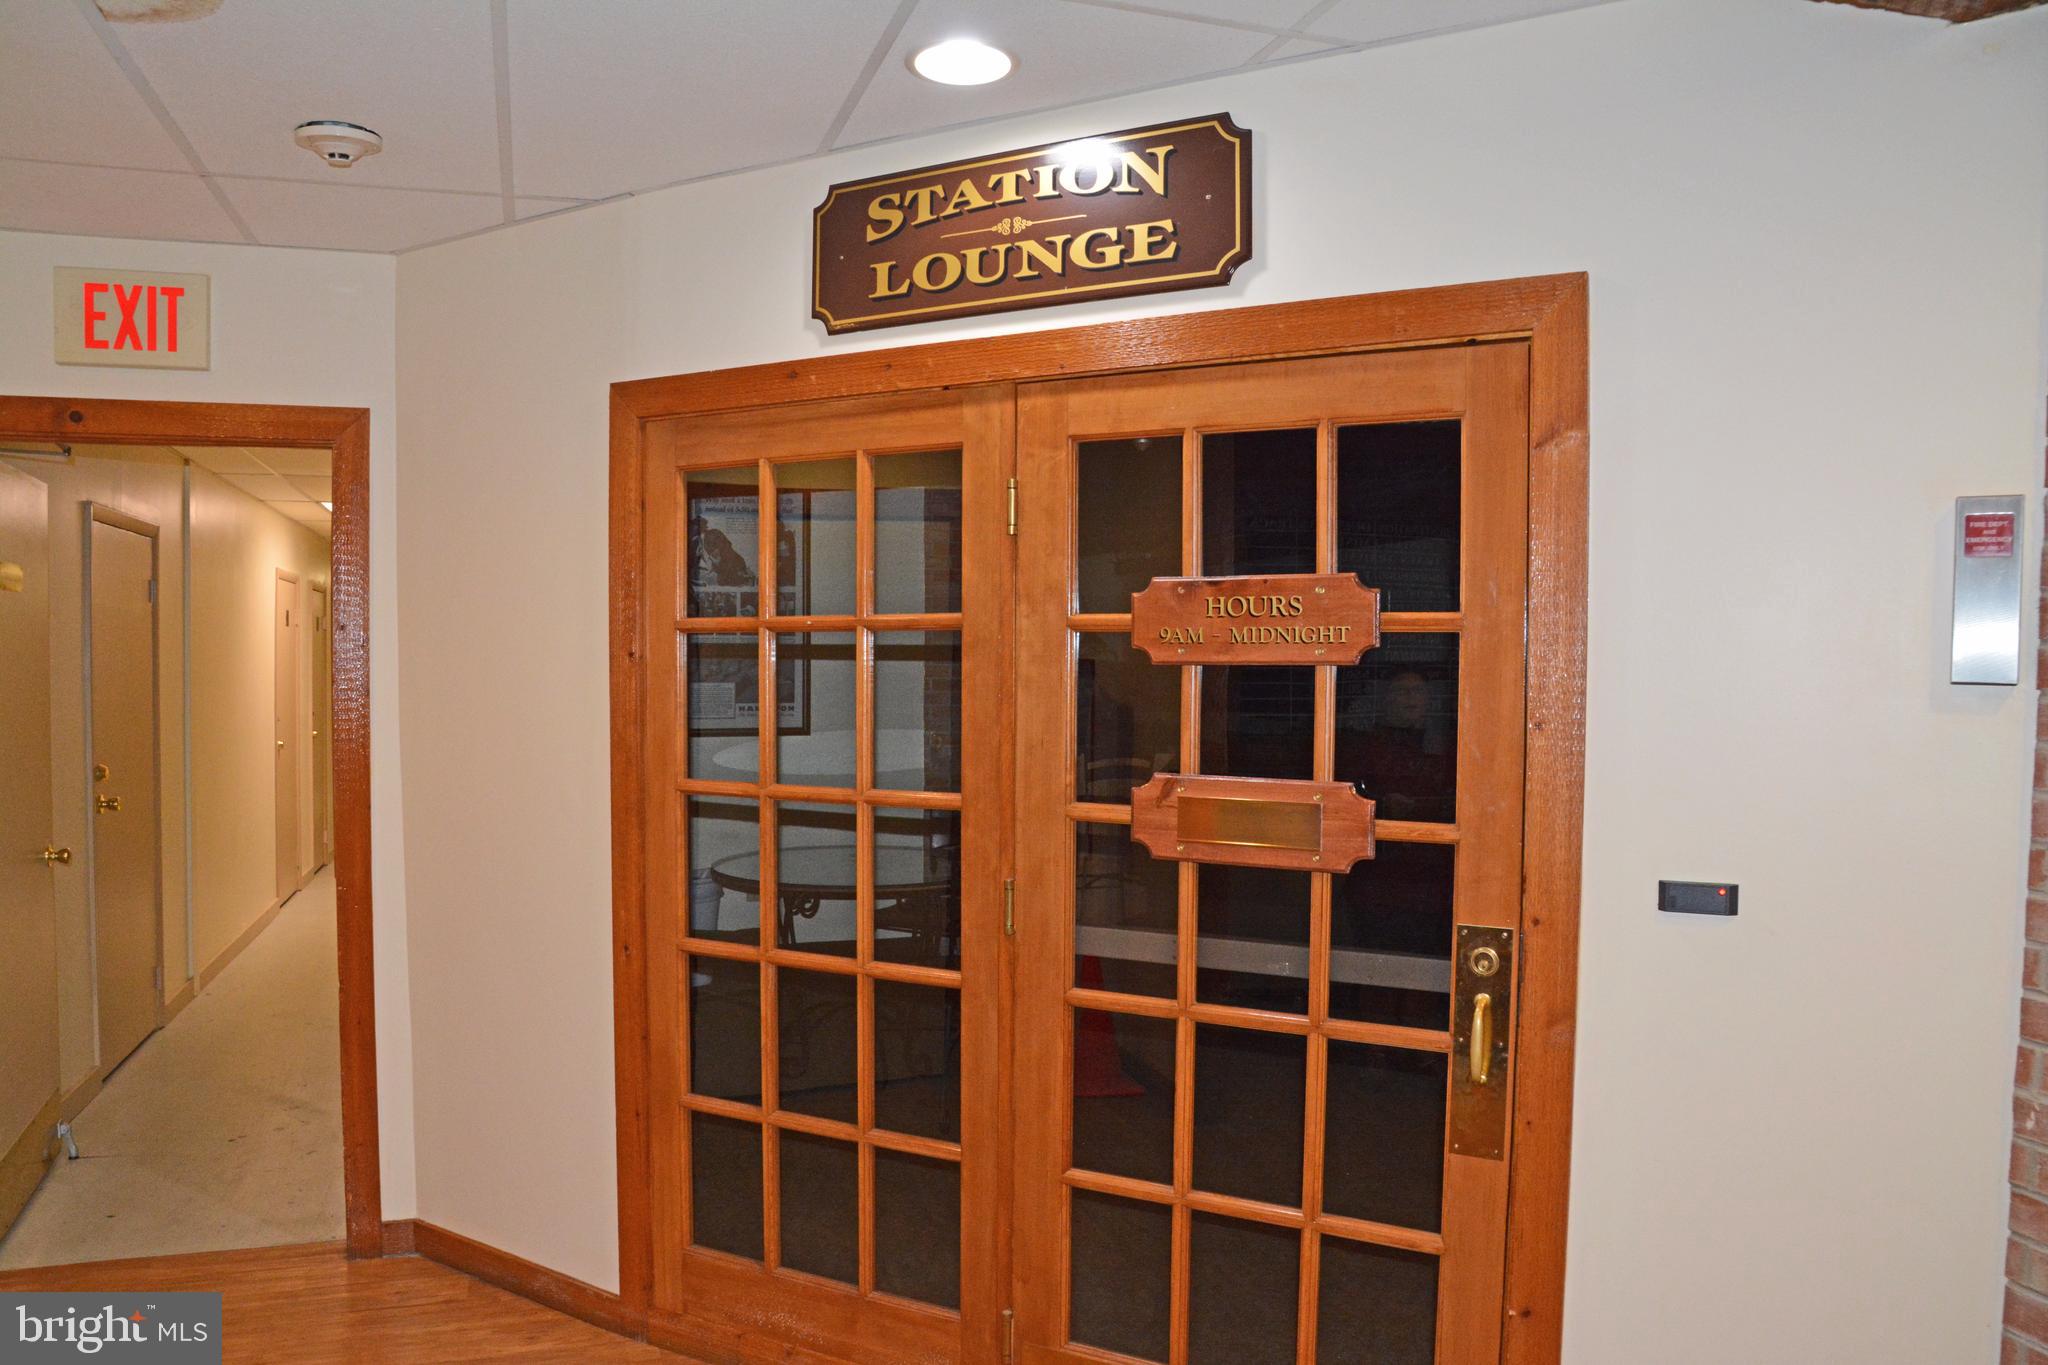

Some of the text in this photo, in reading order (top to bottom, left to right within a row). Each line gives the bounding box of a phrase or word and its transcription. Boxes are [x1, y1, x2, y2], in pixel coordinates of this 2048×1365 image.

[866, 144, 1175, 243] STATION
[868, 218, 1179, 300] LOUNGE
[84, 282, 185, 352] EXIT
[1159, 626, 1205, 644] 9AM
[1229, 626, 1352, 644] MIDNIGHT
[1205, 595, 1303, 617] HOURS
